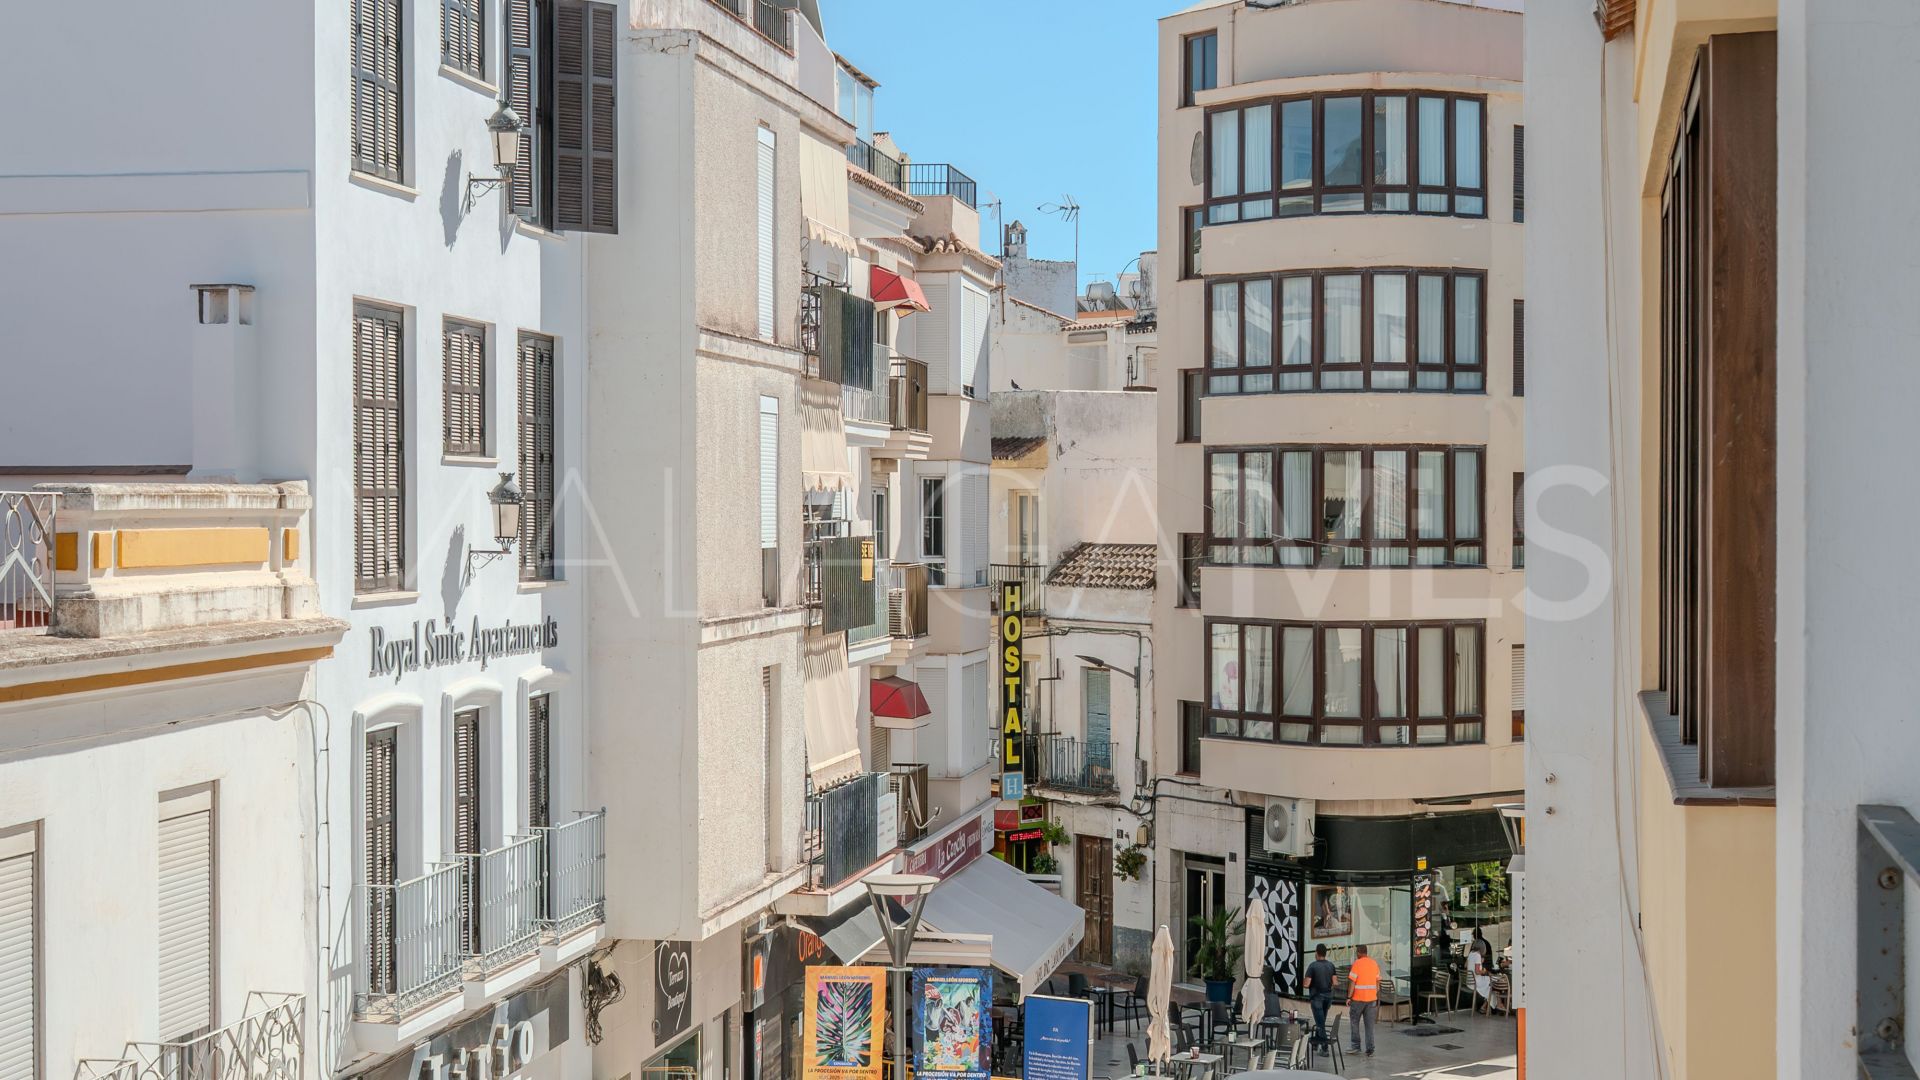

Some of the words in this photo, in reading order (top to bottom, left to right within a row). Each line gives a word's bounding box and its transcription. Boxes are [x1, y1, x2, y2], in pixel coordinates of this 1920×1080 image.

[369, 620, 421, 684] Royal
[424, 617, 465, 669] Suite
[468, 614, 558, 671] Apartaments
[1003, 585, 1022, 765] HOSTAL
[937, 848, 946, 869] La
